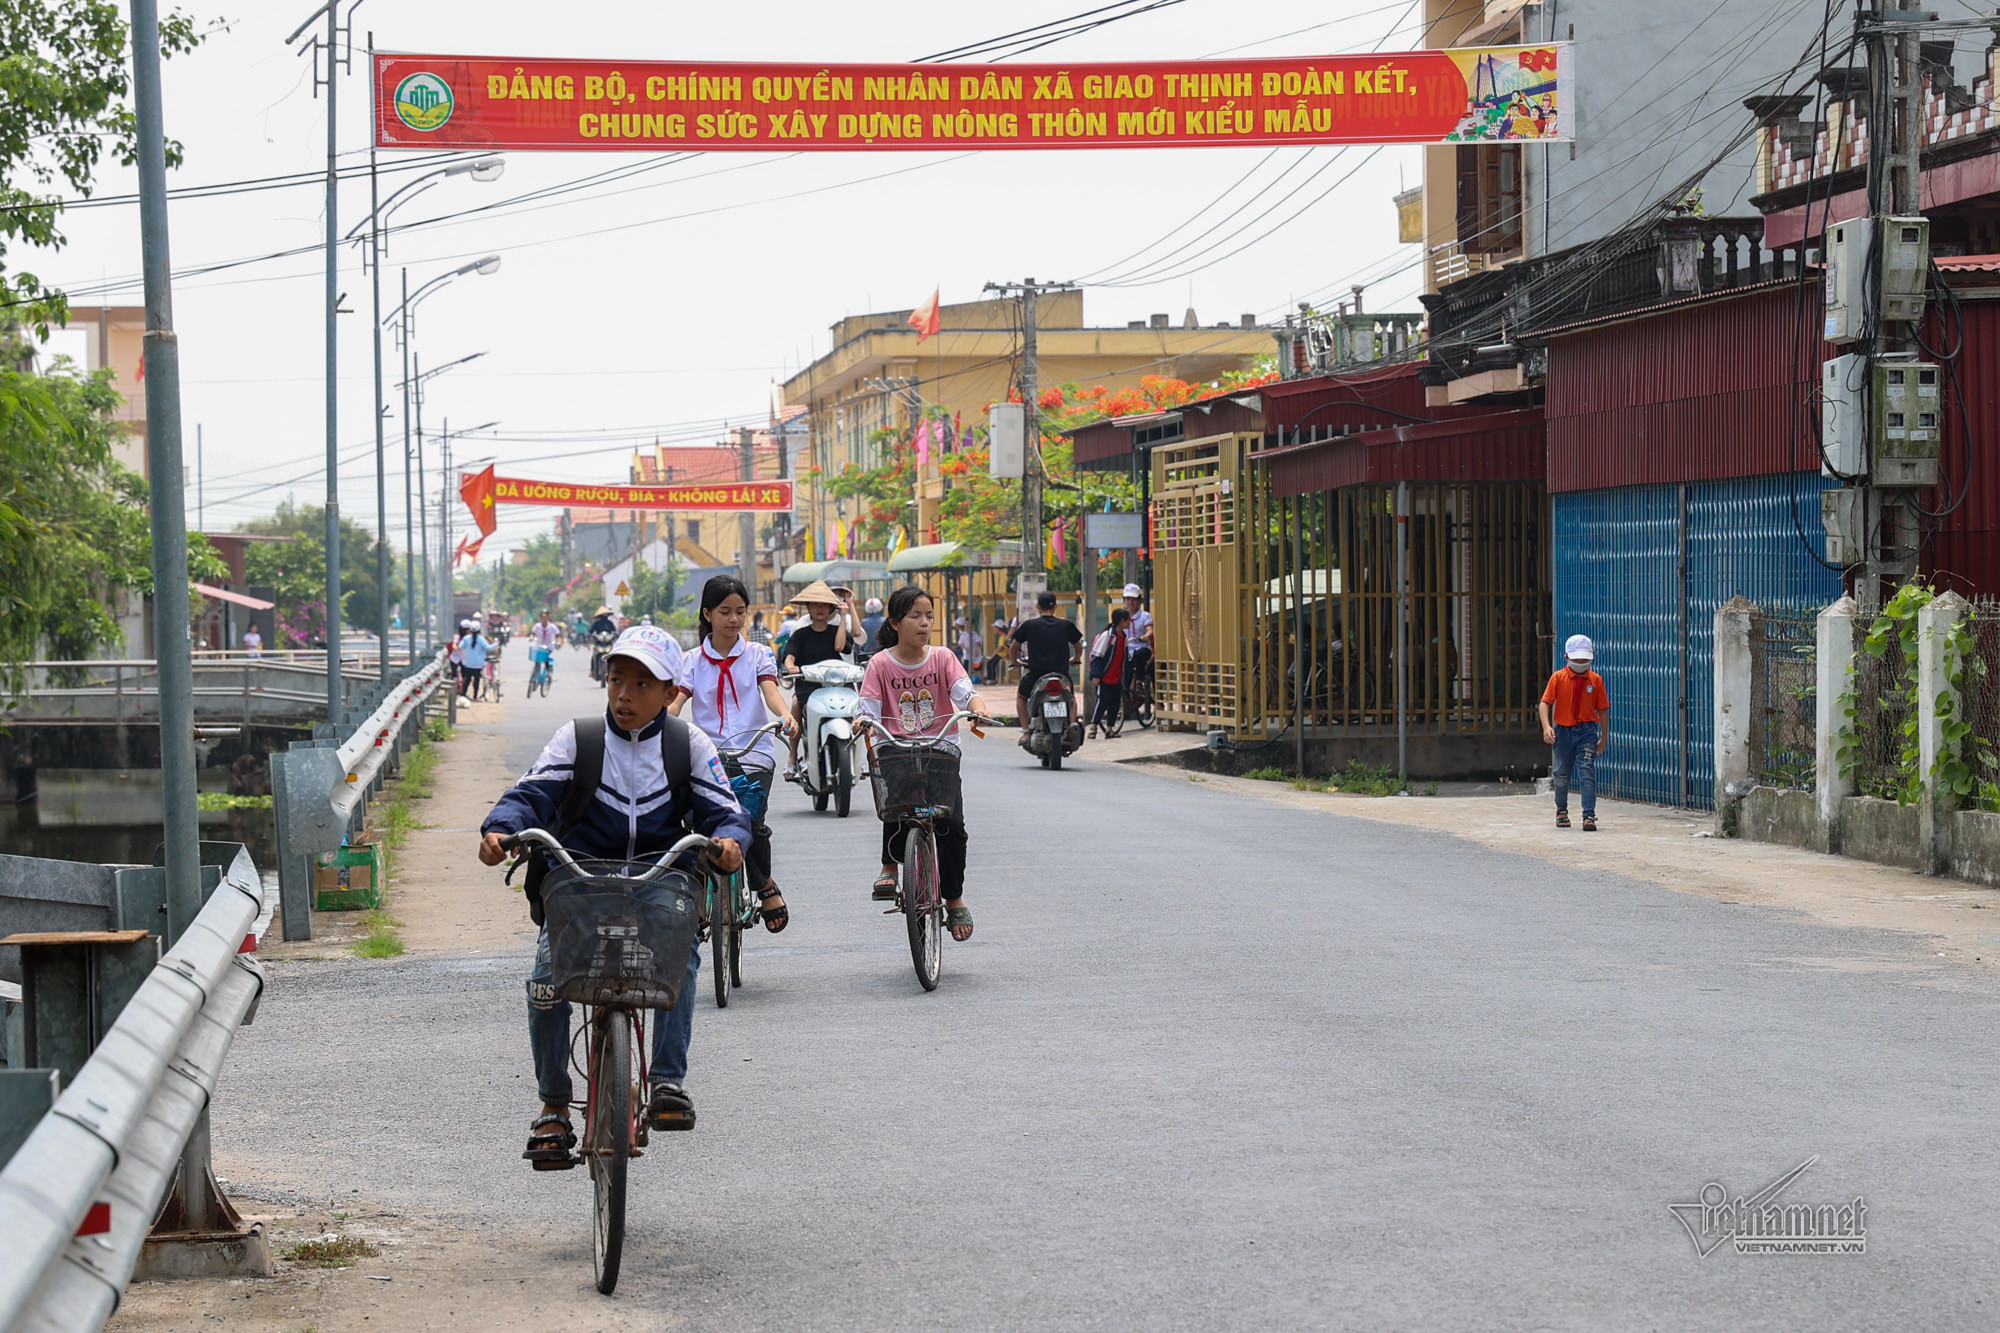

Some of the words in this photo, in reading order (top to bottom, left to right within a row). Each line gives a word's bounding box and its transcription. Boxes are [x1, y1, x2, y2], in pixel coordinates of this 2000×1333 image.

[487, 68, 573, 99] ĐẢNG
[585, 71, 635, 105] BỘ,
[647, 71, 741, 100] CHÍNH
[753, 69, 853, 100] QUYỀN
[864, 72, 949, 100] NHÂN
[961, 72, 1022, 99] DÂN
[1033, 71, 1073, 99] XÃ
[1084, 75, 1153, 99] GIAO
[1164, 73, 1252, 102] THỊNH
[1262, 67, 1344, 96] ĐOÀN
[1355, 62, 1416, 95] KẾT,
[580, 113, 685, 138] CHUNG
[697, 109, 757, 138] SỨC
[768, 110, 828, 137] XÂY
[839, 112, 921, 143] DỰNG
[933, 109, 1017, 137] NÔNG
[1028, 108, 1106, 136] THÔN
[1118, 107, 1175, 135] MỚI
[1186, 101, 1253, 135] KIỂU
[1265, 100, 1332, 132] MẪU
[495, 481, 519, 497] ĐÃ
[523, 482, 571, 500] UỐNG
[575, 487, 624, 505] RƯỢU,
[629, 490, 655, 502] BIA
[669, 488, 728, 503] KHÔNG
[731, 487, 756, 503] LÁI
[760, 489, 781, 503] XE
[891, 673, 939, 690] GUCCI
